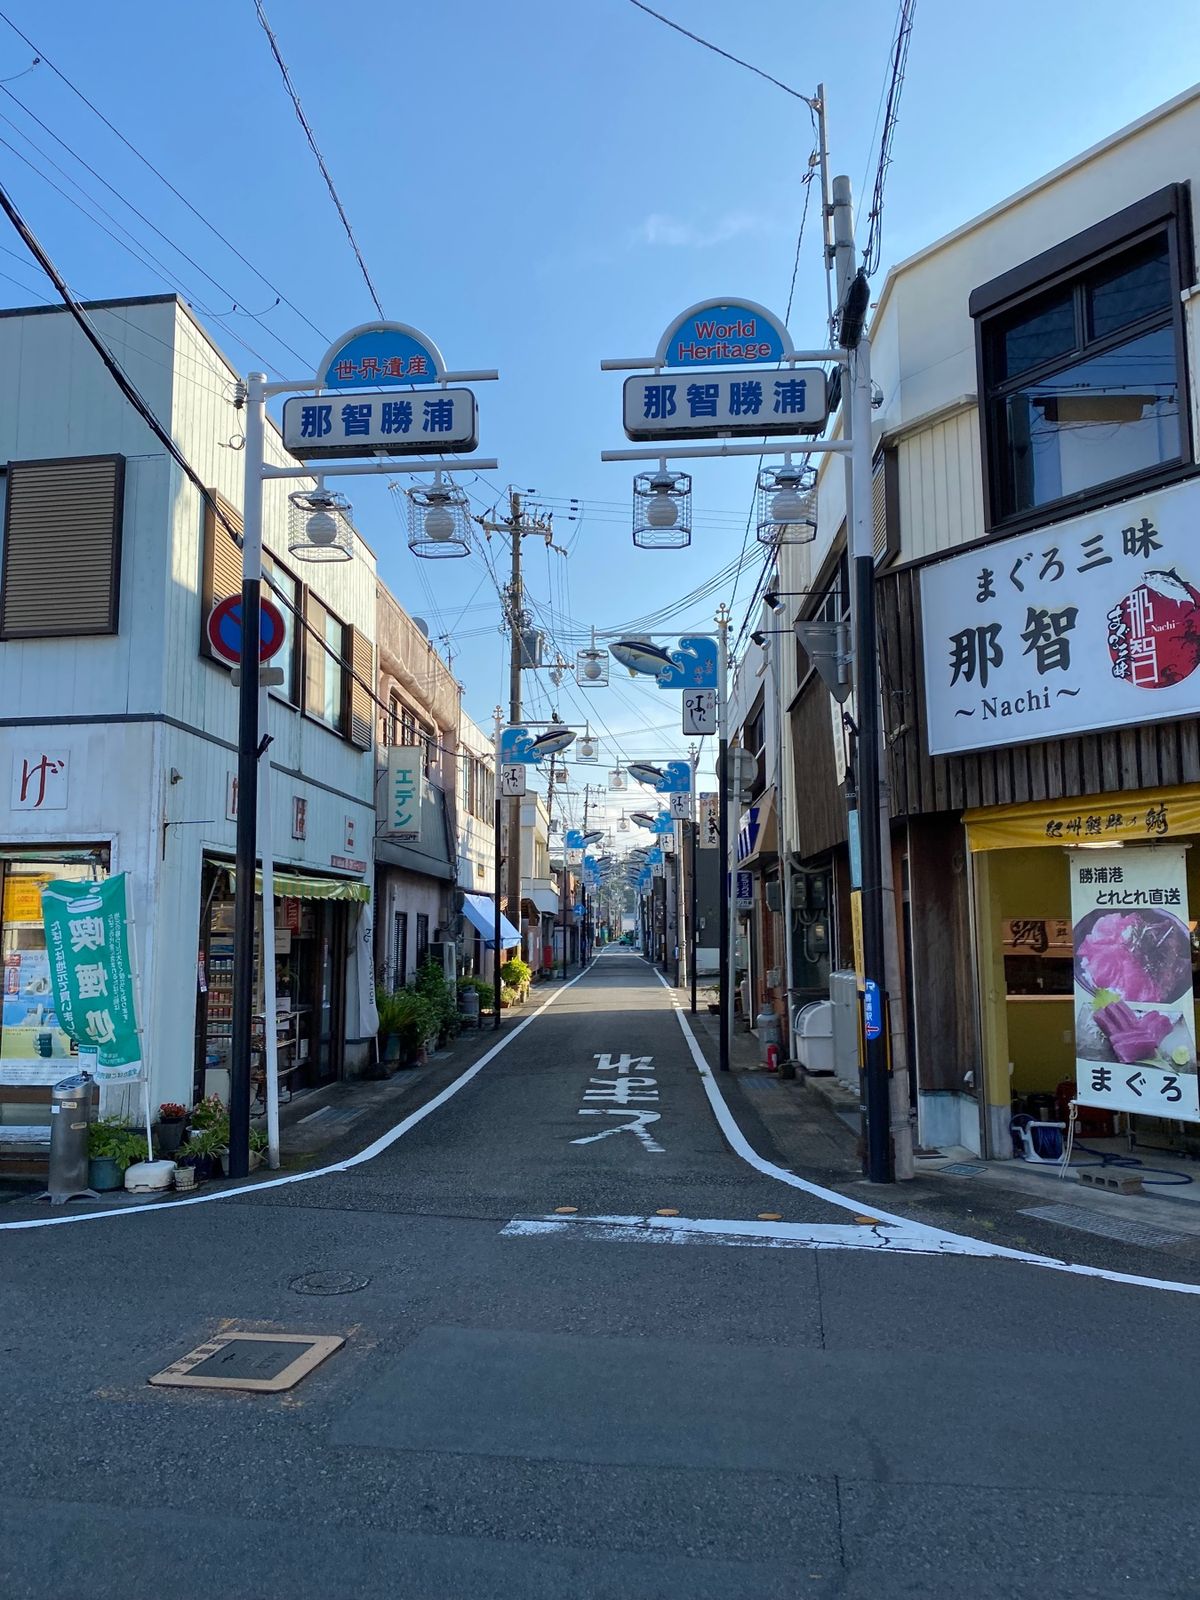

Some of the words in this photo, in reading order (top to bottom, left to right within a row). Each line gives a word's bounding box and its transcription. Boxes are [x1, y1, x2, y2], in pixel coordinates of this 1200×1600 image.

[694, 320, 756, 339] World
[334, 354, 429, 381] 世界遺産
[678, 341, 772, 361] Heritage
[300, 399, 455, 438] 那智勝浦
[643, 379, 808, 419] 那智勝浦
[976, 518, 1163, 603] まぐろ三昧
[947, 607, 1080, 689] 那智
[1127, 588, 1159, 686] 那智
[19, 754, 65, 808] げ
[394, 769, 416, 828] エデン
[1079, 866, 1124, 884] 勝浦港
[1095, 887, 1181, 906] とれとれ直送
[1091, 1066, 1183, 1103] まぐろ
